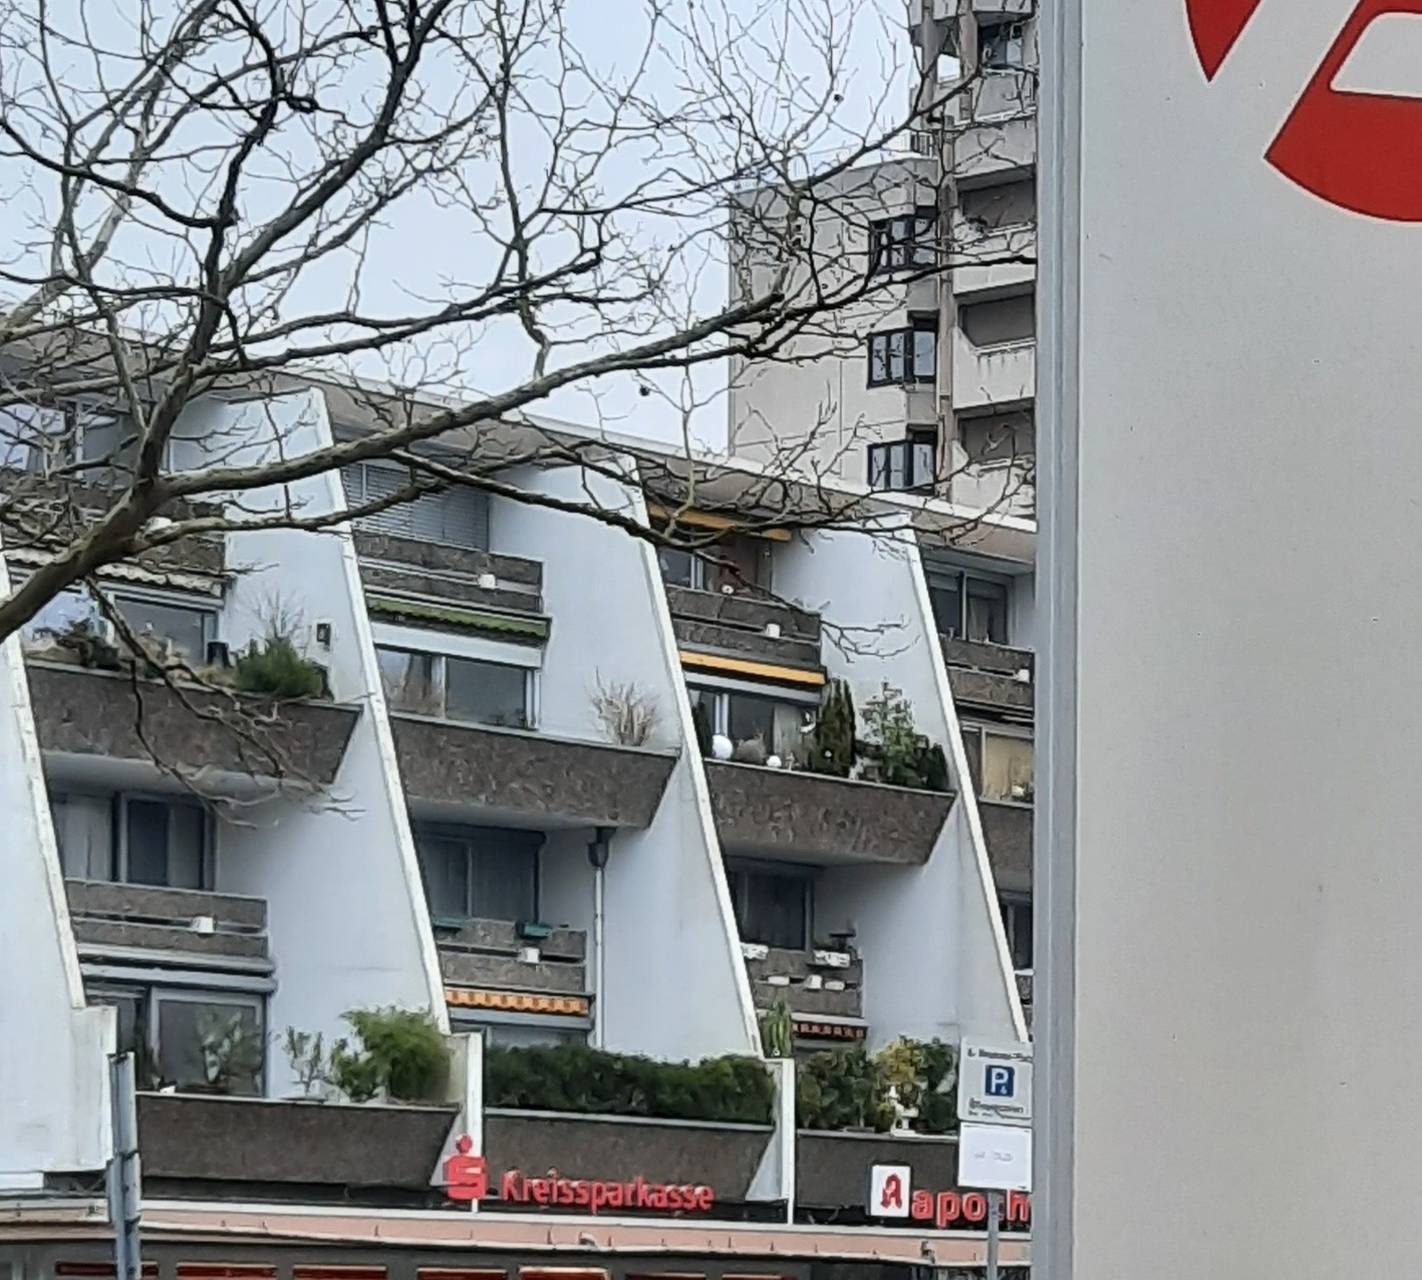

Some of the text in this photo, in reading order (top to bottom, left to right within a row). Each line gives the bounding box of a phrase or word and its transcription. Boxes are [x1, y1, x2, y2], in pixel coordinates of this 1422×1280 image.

[991, 1067, 1009, 1093] P
[501, 1168, 715, 1215] Kreissparkasse
[911, 1188, 1031, 1229] apoh
